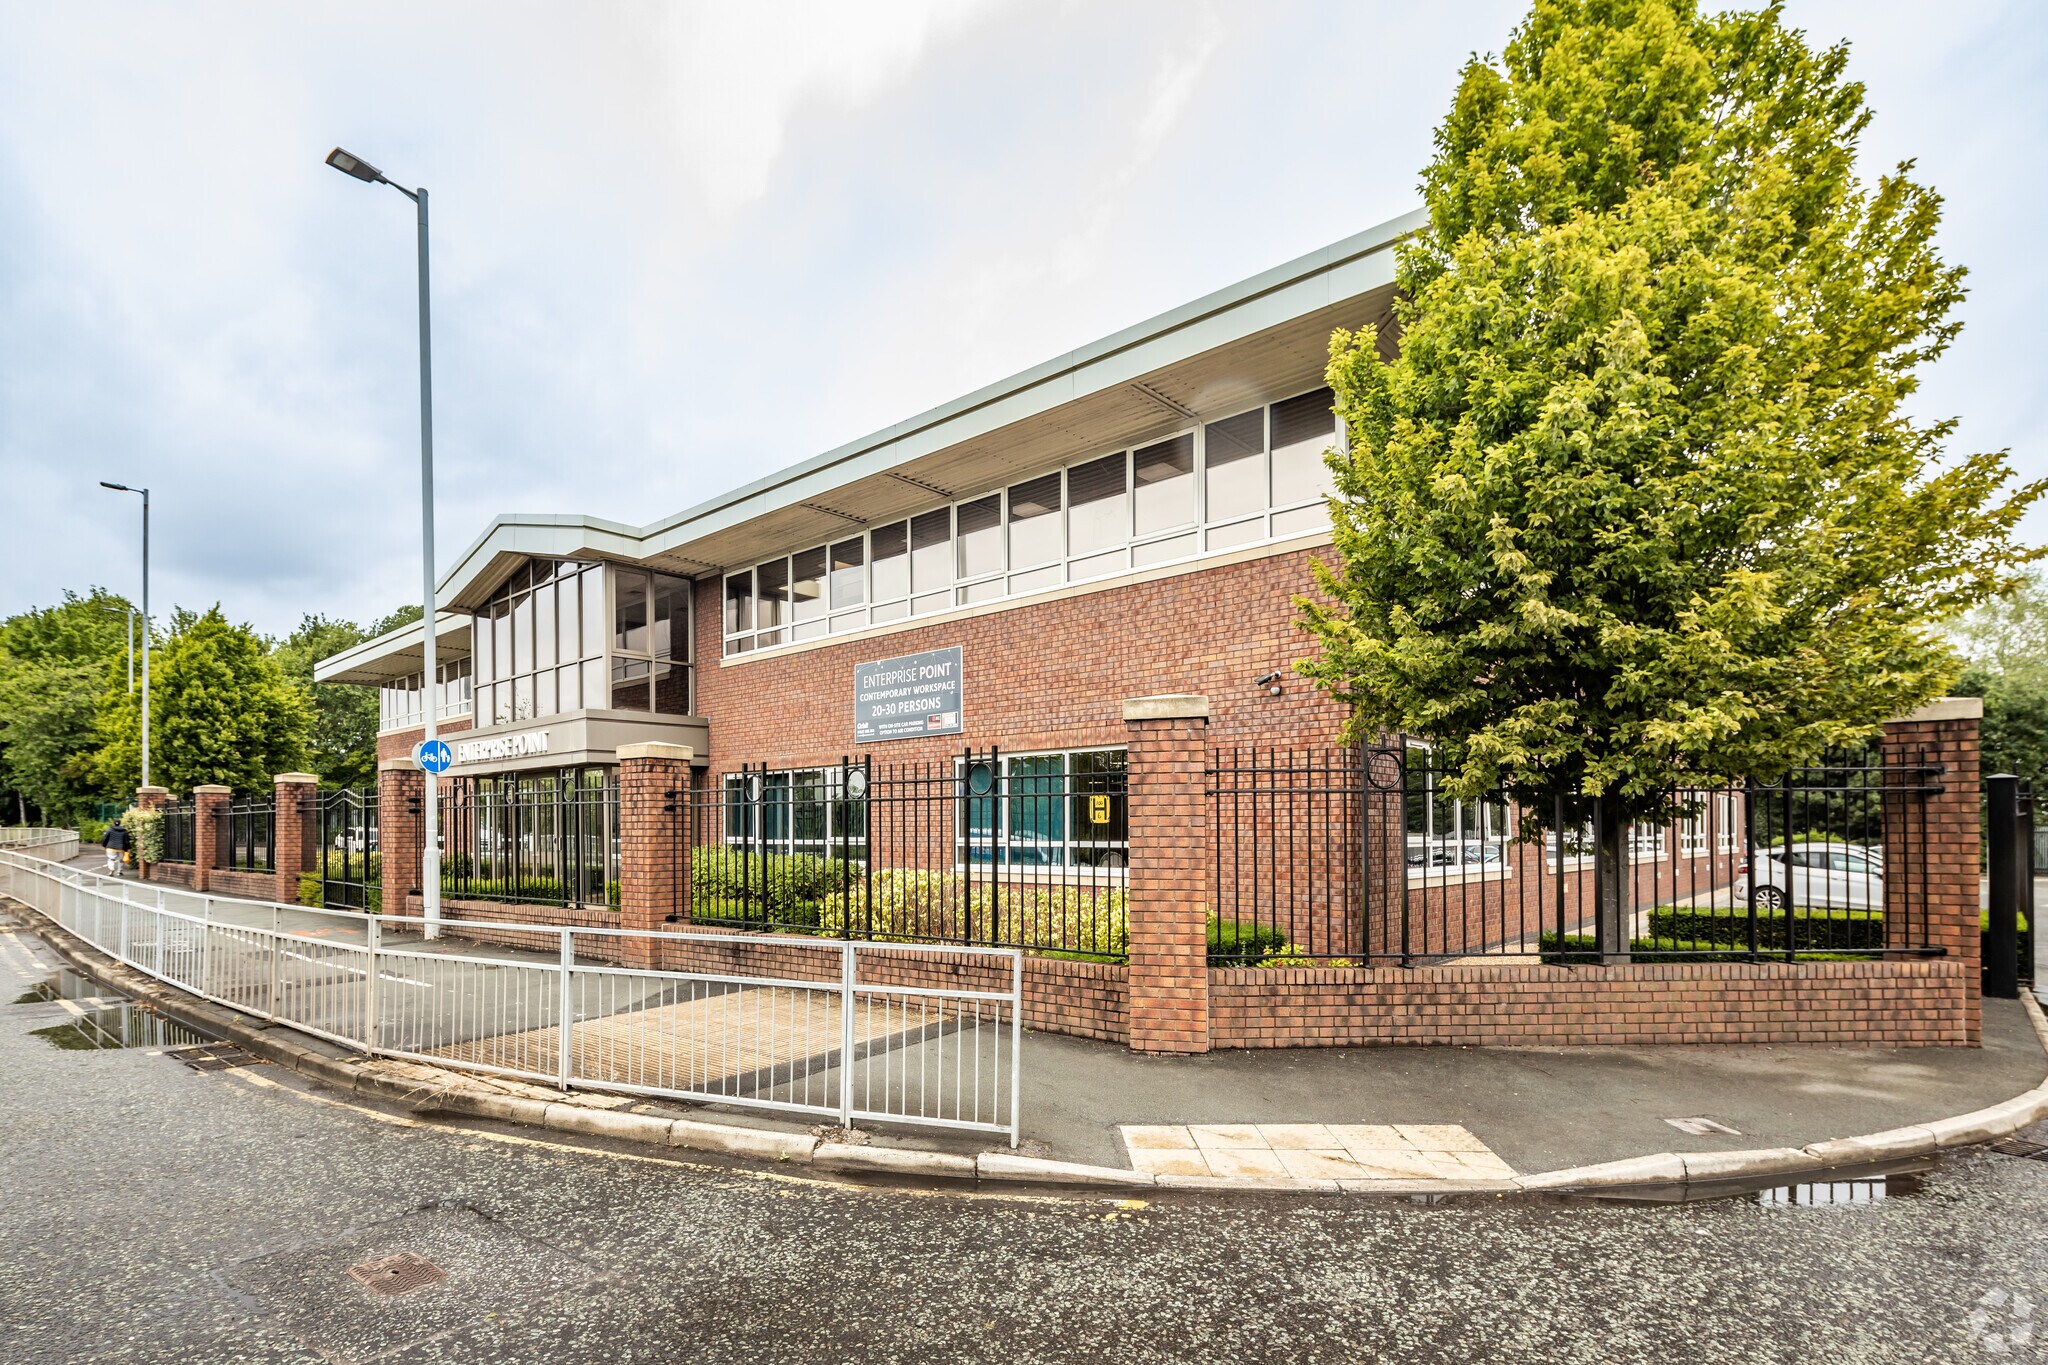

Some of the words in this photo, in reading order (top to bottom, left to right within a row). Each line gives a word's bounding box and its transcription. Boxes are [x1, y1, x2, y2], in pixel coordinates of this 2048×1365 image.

[864, 668, 916, 688] ENTERPRISE
[919, 662, 952, 680] POINT
[860, 687, 912, 702] CONTEMPORARY
[913, 681, 956, 694] WORKSPACE
[872, 703, 896, 717] 20-30
[898, 697, 941, 713] PERSONS
[458, 737, 512, 762] ENTERPRISE
[512, 731, 549, 755] POINT
